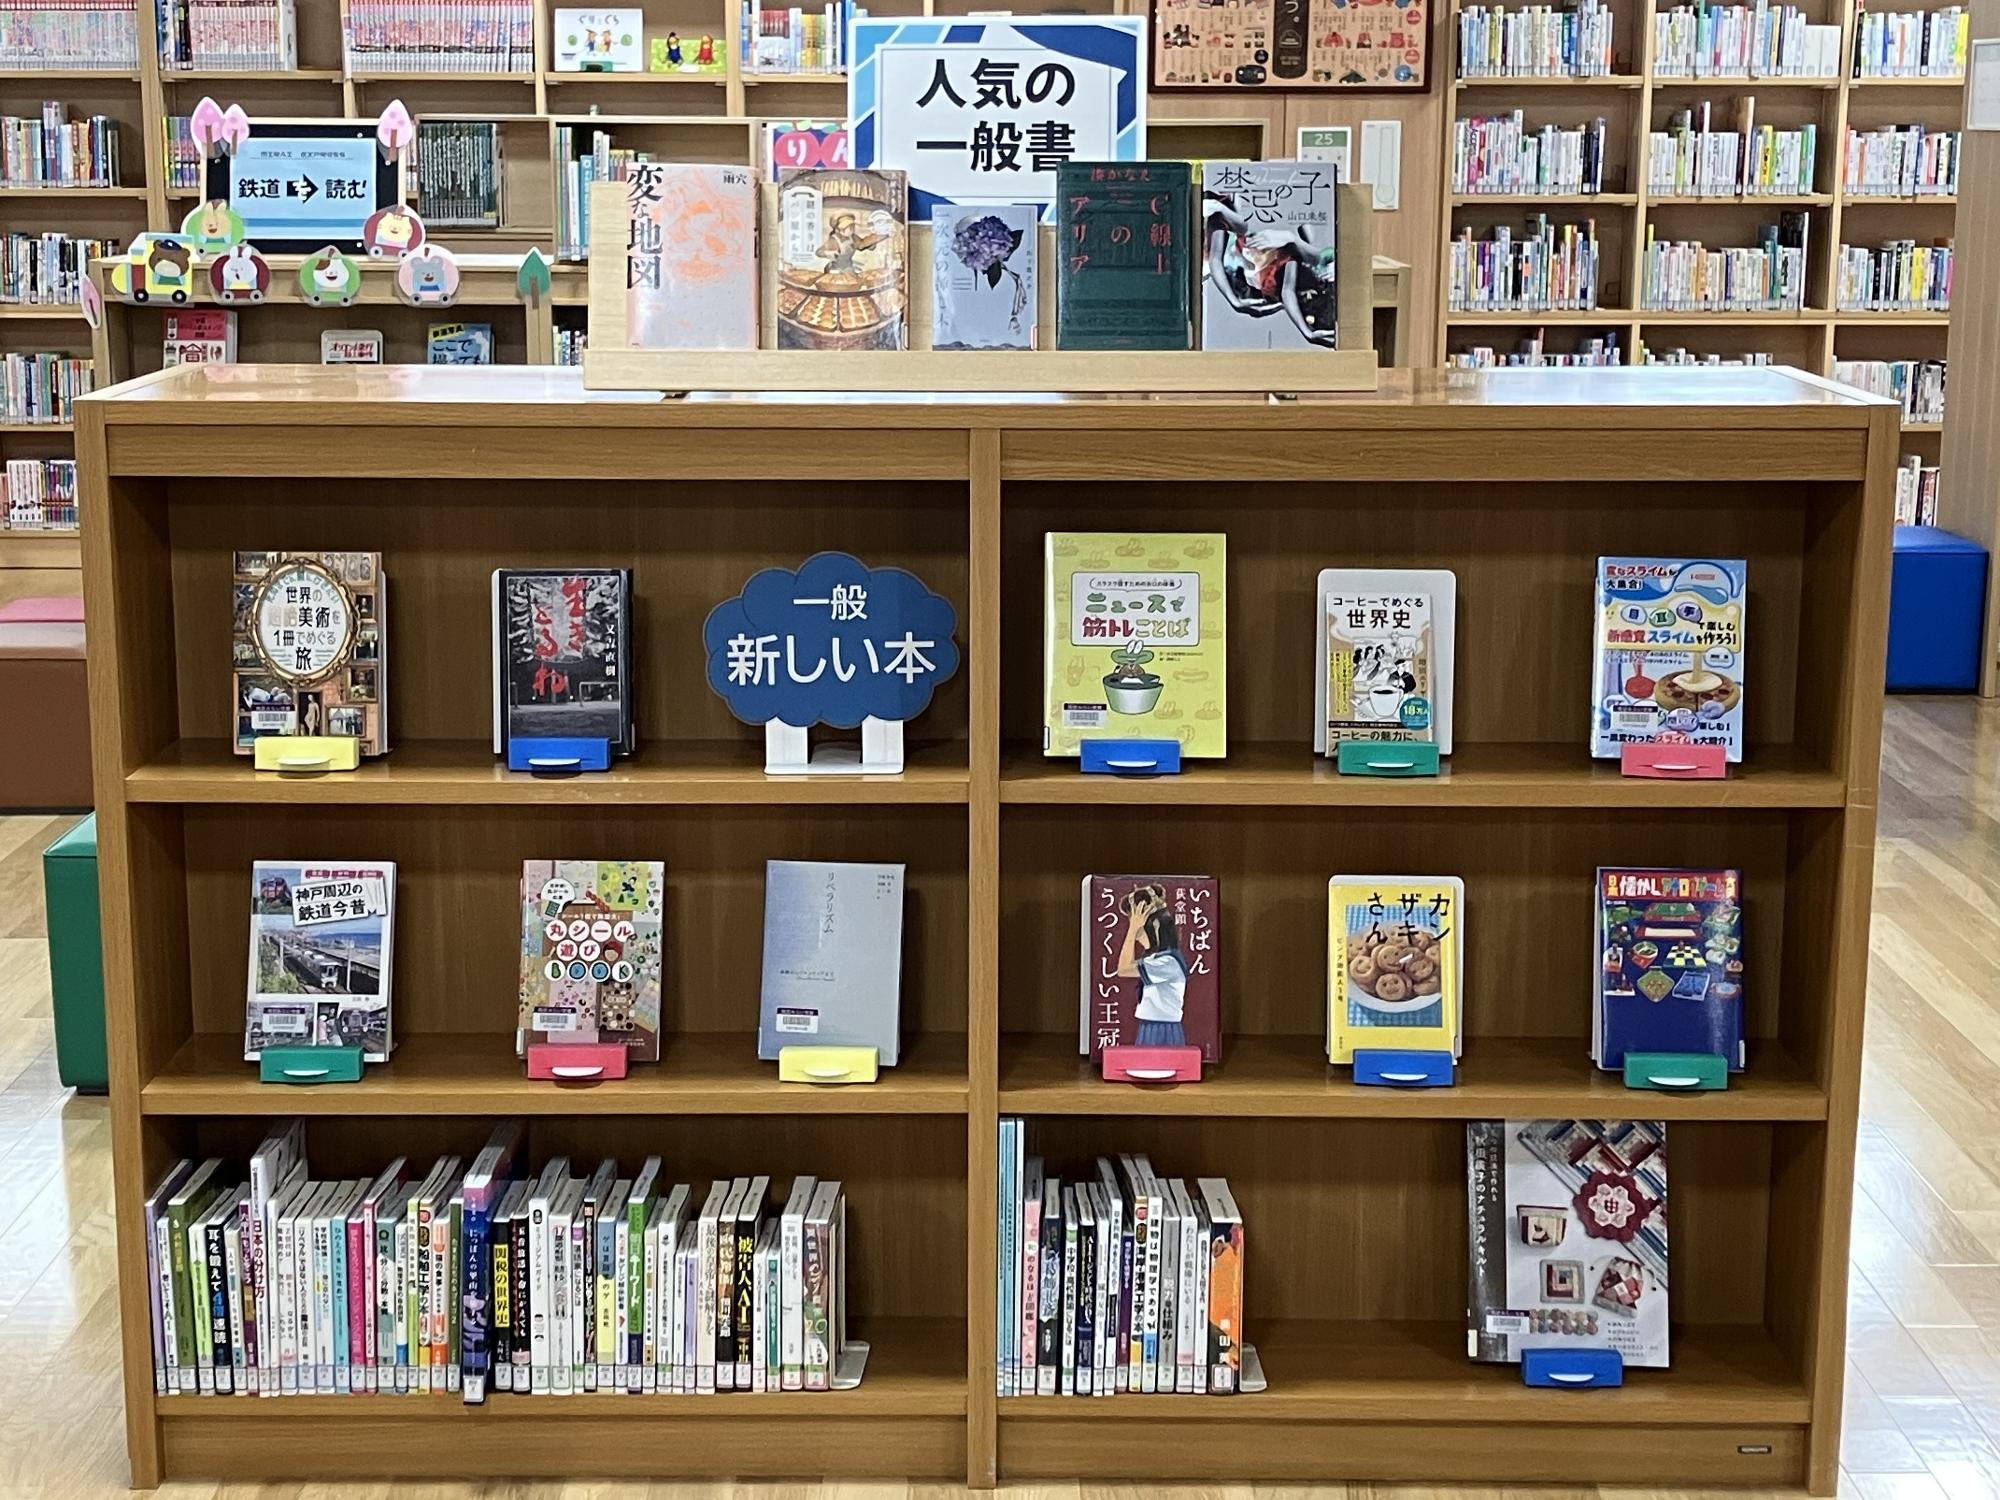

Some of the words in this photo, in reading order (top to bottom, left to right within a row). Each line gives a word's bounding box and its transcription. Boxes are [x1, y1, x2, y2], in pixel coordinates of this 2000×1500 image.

[916, 57, 1077, 109] 人気の
[916, 119, 1077, 173] 一般書
[1315, 134, 1334, 145] 25
[723, 169, 748, 185] 雨穴
[238, 178, 281, 199] 鉄道
[325, 178, 368, 199] 読む
[1212, 165, 1331, 224] 禁忌の子
[626, 164, 664, 290] 変な地図
[286, 586, 323, 604] 世界の
[793, 584, 868, 620] 一般
[1085, 592, 1186, 613] ニュースで
[1333, 597, 1424, 607] コーヒーでめぐる
[1082, 616, 1191, 638] 筋トレことば
[1346, 609, 1411, 629] 世界史
[273, 629, 337, 646] 1冊でめぐる
[295, 647, 312, 670] 旅
[727, 631, 937, 686] 新しい本
[295, 883, 363, 900] 神戸周辺の
[298, 899, 366, 921] 鉄道今昔
[550, 923, 630, 937] 丸シール
[1189, 887, 1211, 975] いちばん
[560, 944, 597, 957] 遊び
[1098, 887, 1120, 1049] うつくしい王冠
[253, 1219, 265, 1299] 日本の分け方
[495, 1247, 508, 1325] 関税の世界史
[629, 1254, 641, 1307] キーワード
